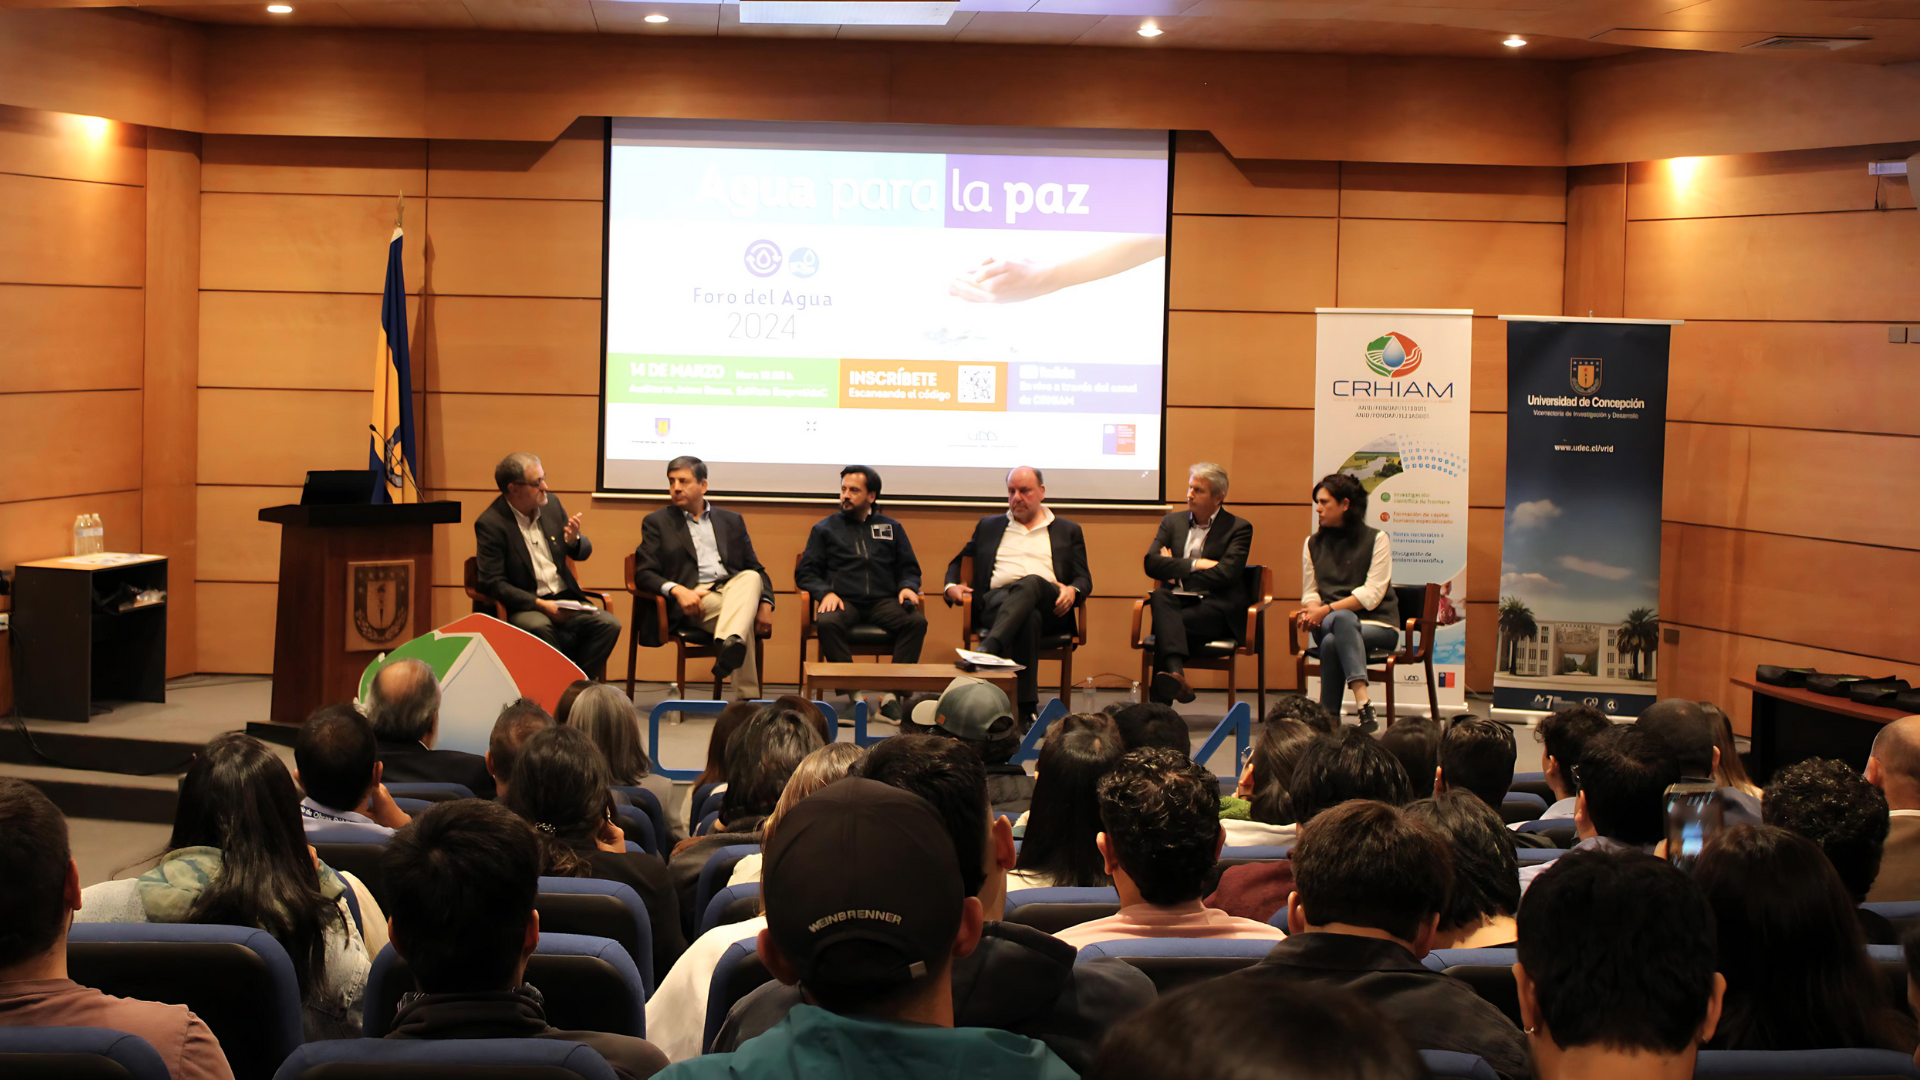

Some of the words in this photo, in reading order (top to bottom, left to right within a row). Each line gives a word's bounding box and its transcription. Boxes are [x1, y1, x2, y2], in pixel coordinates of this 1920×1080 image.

[694, 161, 817, 218] Agua
[830, 179, 940, 220] para
[952, 168, 993, 212] la
[1003, 182, 1090, 224] paz
[693, 287, 737, 304] Foro
[744, 288, 775, 305] del
[781, 290, 833, 310] Agua
[727, 311, 796, 340] 2024
[630, 361, 646, 378] 14
[648, 362, 668, 378] DE
[670, 363, 726, 379] MARZO
[849, 367, 938, 387] INSCRÍBETE
[849, 387, 906, 399] Escaneando
[907, 389, 916, 399] el
[918, 389, 951, 402] código
[1333, 380, 1453, 398] CRHIAM
[1528, 395, 1578, 407] Universidad
[1579, 396, 1591, 407] de
[1592, 397, 1645, 410] Concepción
[1554, 444, 1614, 453] www.udec.cl/vrid
[808, 909, 902, 933] WEINBRENNER
